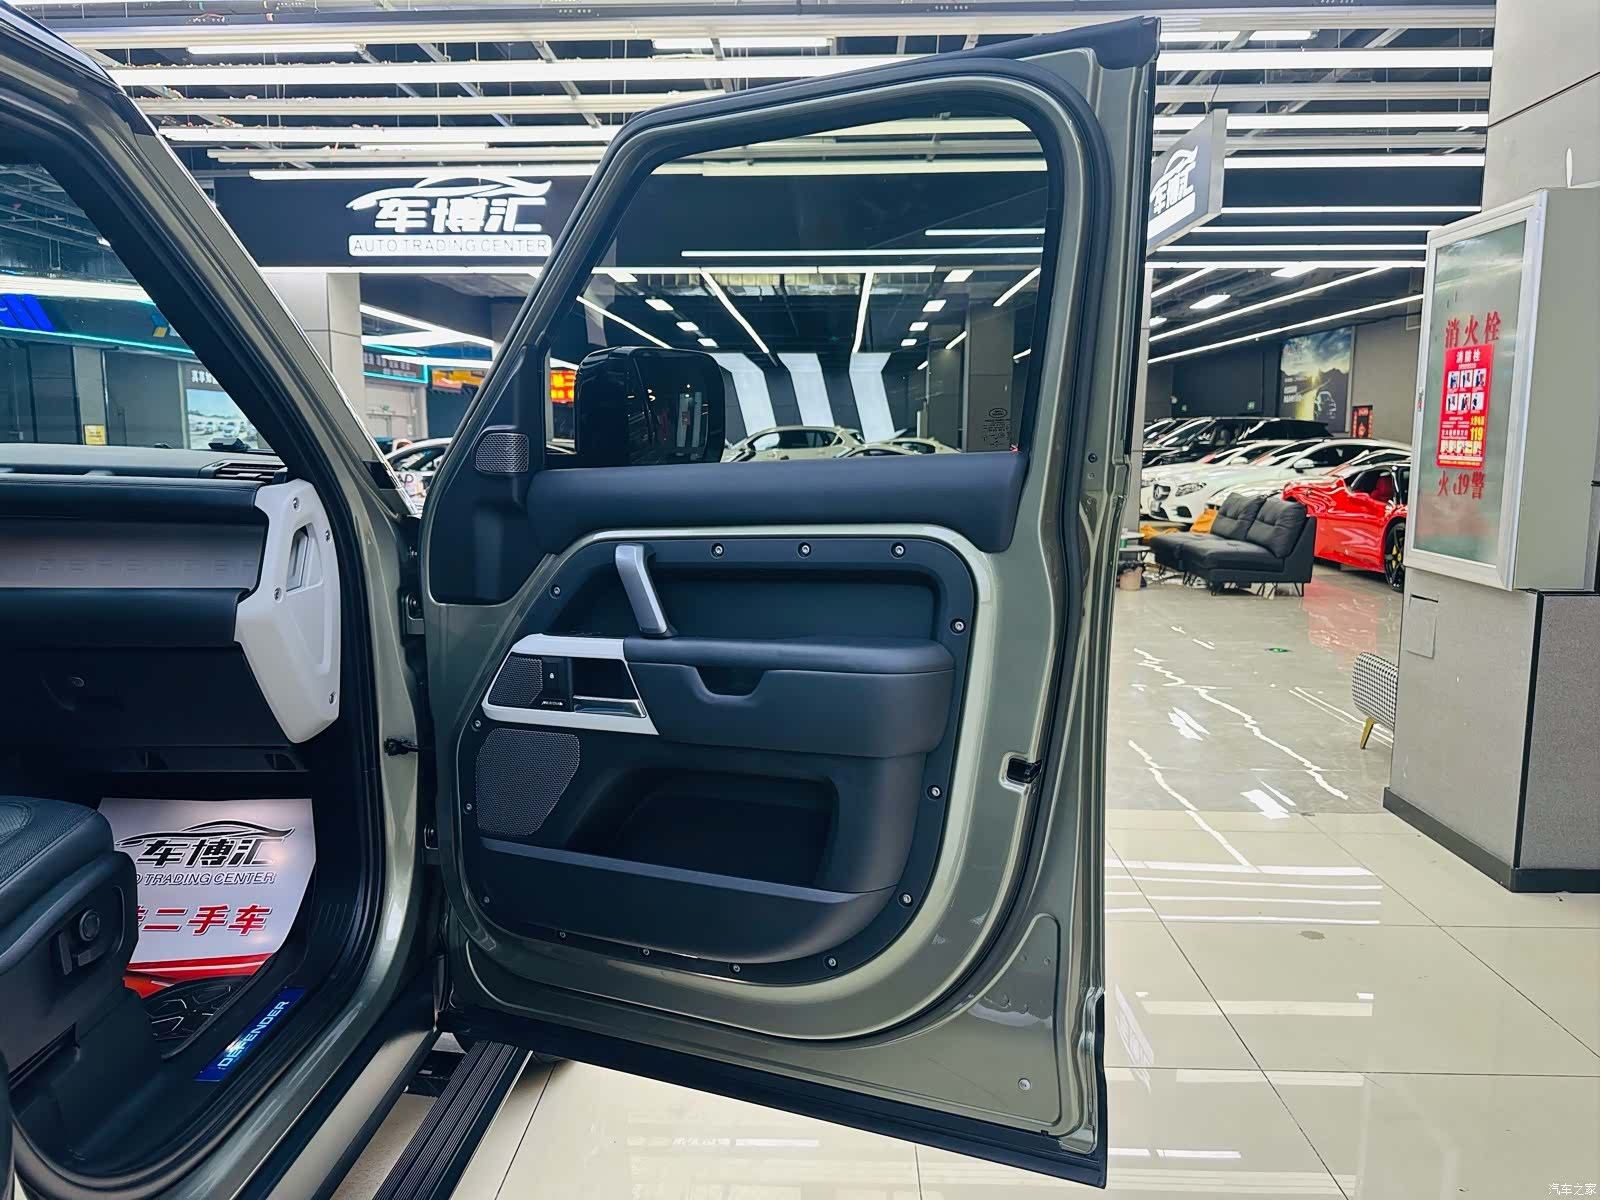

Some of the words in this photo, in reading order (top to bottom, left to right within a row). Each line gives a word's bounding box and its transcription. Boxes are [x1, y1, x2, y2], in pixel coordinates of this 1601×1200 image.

[1153, 160, 1197, 214] 车博汇
[374, 197, 547, 233] 车博汇
[353, 239, 398, 252] AUTO
[404, 239, 476, 252] TRADING
[480, 239, 547, 252] CENTER
[1445, 311, 1502, 348] 消火栓
[1470, 427, 1484, 441] 119
[137, 839, 283, 867] 车博汇
[144, 873, 211, 885] TRADING
[213, 872, 276, 884] CENTER
[217, 1001, 290, 1067] DEFENDER
